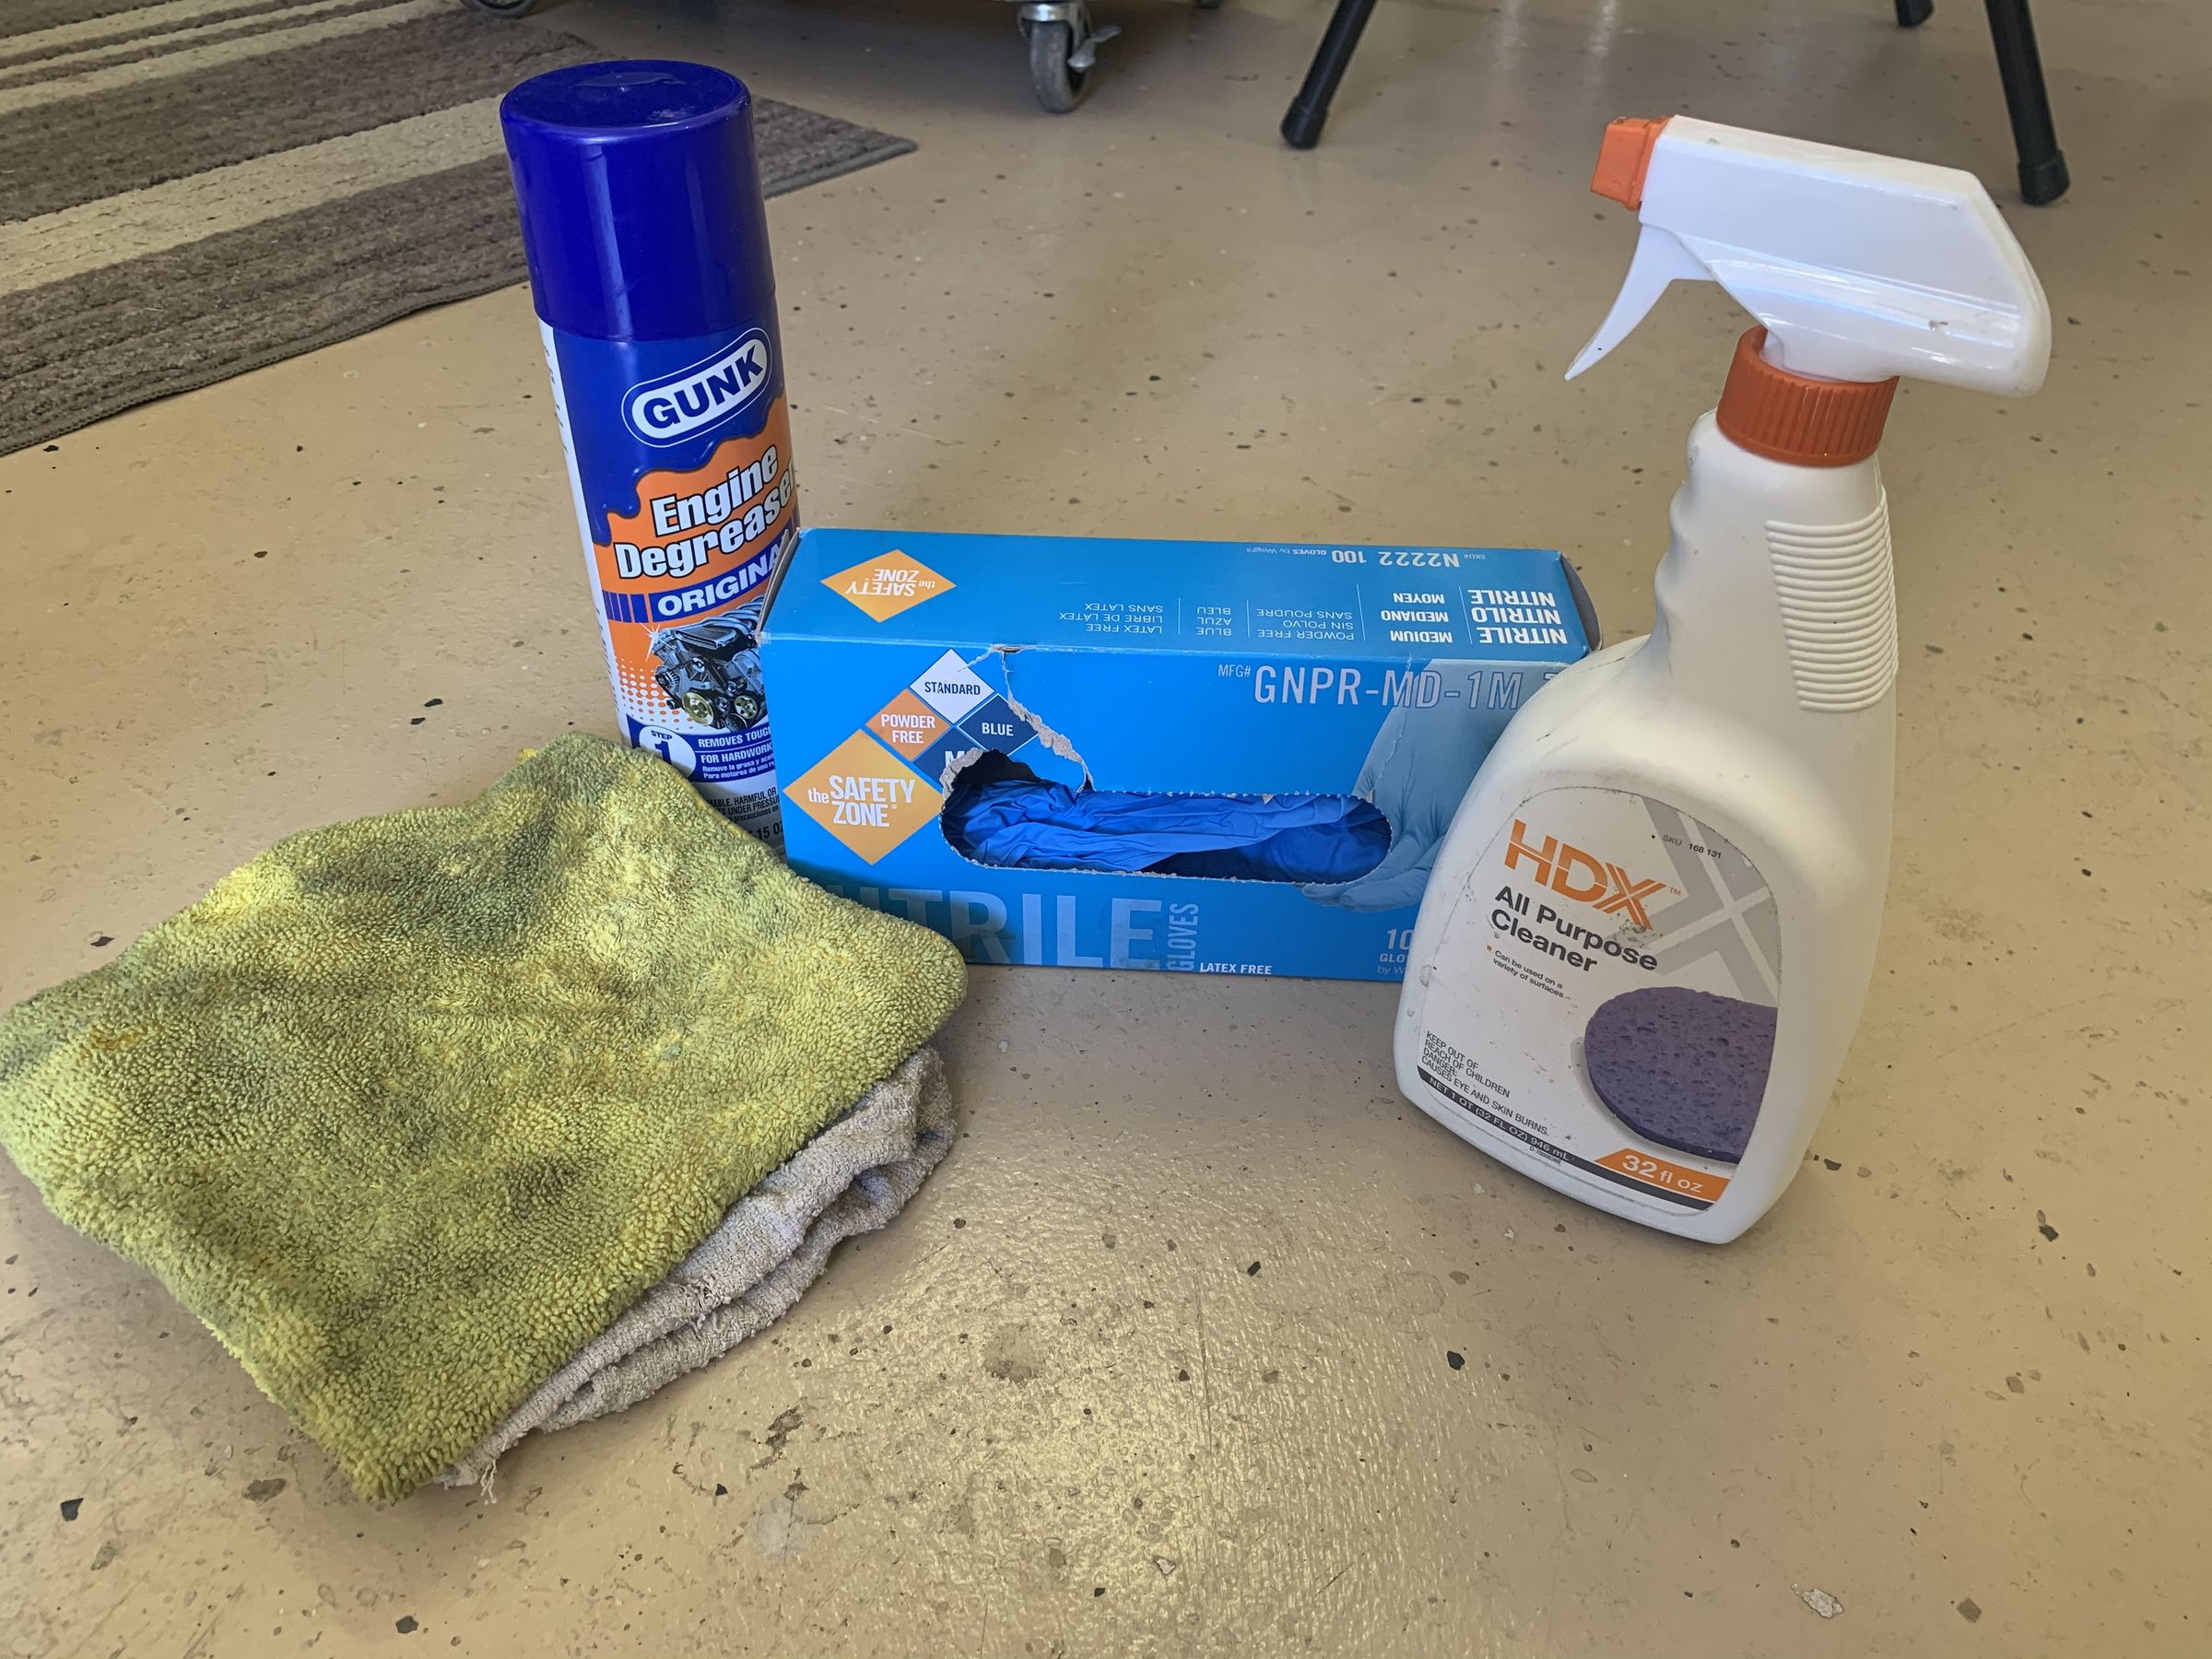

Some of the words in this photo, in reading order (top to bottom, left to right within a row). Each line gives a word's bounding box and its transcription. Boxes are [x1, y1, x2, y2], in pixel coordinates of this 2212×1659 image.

[643, 345, 764, 429] GUNK
[650, 444, 779, 538] Engine
[1332, 550, 1367, 563] 100
[1378, 551, 1461, 568] N2222
[657, 543, 782, 617] ORIGINA
[872, 569, 920, 582] ZONE
[845, 581, 917, 596] SAFETY
[918, 581, 935, 589] the
[1393, 593, 1445, 604] MOYEN
[1467, 589, 1557, 606] NITRILE
[1084, 603, 1124, 611] LATEX
[1128, 605, 1163, 613] SANS
[1197, 606, 1231, 615] BLEU
[1256, 608, 1312, 618] POUDRE
[1059, 612, 1099, 622] LATEX
[1103, 614, 1120, 622] DE
[1124, 614, 1163, 623] LIBRE
[1197, 617, 1231, 625] AZUL
[1317, 611, 1352, 619] SANS
[1381, 609, 1449, 622] MEDIANO
[1471, 606, 1561, 624] NITRILO
[1086, 623, 1119, 632] FREE
[1124, 625, 1162, 633] LATEX
[1283, 619, 1325, 629] POLVO
[1332, 621, 1354, 629] SIN
[1196, 627, 1231, 636] BLUE
[1257, 629, 1290, 638] FREE
[1297, 630, 1354, 640] POWDER
[1390, 630, 1453, 643] MEDIUM
[1476, 627, 1568, 644] NITRILE
[924, 681, 981, 695] STANDARD
[1218, 665, 1252, 677] MFG#
[1254, 665, 1524, 710] GNPR-MD-1M
[880, 713, 935, 728] POWDER
[651, 730, 673, 740] STEP
[982, 723, 1014, 736] BLUE
[698, 735, 743, 747] REMOVES
[892, 730, 924, 744] FREE
[654, 740, 672, 764] 1
[700, 754, 719, 763] FOR
[721, 742, 772, 762] HARDWORK
[735, 760, 755, 771] grasa
[721, 770, 747, 778] motores
[734, 791, 766, 806] HARMFUL
[768, 787, 777, 797] OR
[807, 787, 829, 804] the
[829, 775, 915, 803] SAFETY
[728, 805, 752, 815] UNDER
[831, 800, 890, 827] ZONE
[757, 826, 770, 840] 15
[1662, 834, 1683, 846] SKU
[1688, 843, 1704, 853] 168
[1707, 849, 1722, 859] 131
[1504, 818, 1667, 930] HDX
[830, 883, 1162, 971] TRILE
[1495, 885, 1530, 916] All
[1535, 904, 1658, 971] Purpose
[1166, 902, 1199, 971] GLOVES
[1387, 929, 1414, 950] 10
[1491, 909, 1598, 972] Cleaner
[1380, 953, 1406, 963] GLO
[1199, 962, 1236, 972] LATEX
[1241, 964, 1272, 974] FREE
[1377, 965, 1391, 974] by
[1495, 950, 1511, 963] Can
[1512, 959, 1523, 969] be
[1524, 966, 1544, 980] used
[1545, 977, 1556, 986] on
[1493, 958, 1519, 976] variety
[1529, 978, 1564, 998] surfaces
[1426, 1030, 1447, 1049] KEEP
[1448, 1046, 1465, 1062] OUT
[1466, 1058, 1479, 1070] OF
[1425, 1039, 1452, 1063] REACH
[1453, 1059, 1465, 1070] OF
[1465, 1067, 1511, 1099] CHILDREN
[1421, 1055, 1453, 1082] CAUSES
[1453, 1077, 1470, 1094] EYE
[1470, 1089, 1489, 1105] AND
[1491, 1100, 1513, 1118] SKIN
[1514, 1112, 1549, 1136] BURNS.
[1430, 1077, 1450, 1093] NET
[1459, 1098, 1475, 1111] QT
[1476, 1107, 1491, 1121] (32
[1493, 1116, 1506, 1130] FL
[1509, 1126, 1528, 1141] OZ)
[1530, 1137, 1550, 1151] 946
[1552, 1148, 1570, 1161] mL
[1622, 1155, 1658, 1179] 32
[1660, 1170, 1674, 1184] fl
[1677, 1179, 1703, 1194] oz
